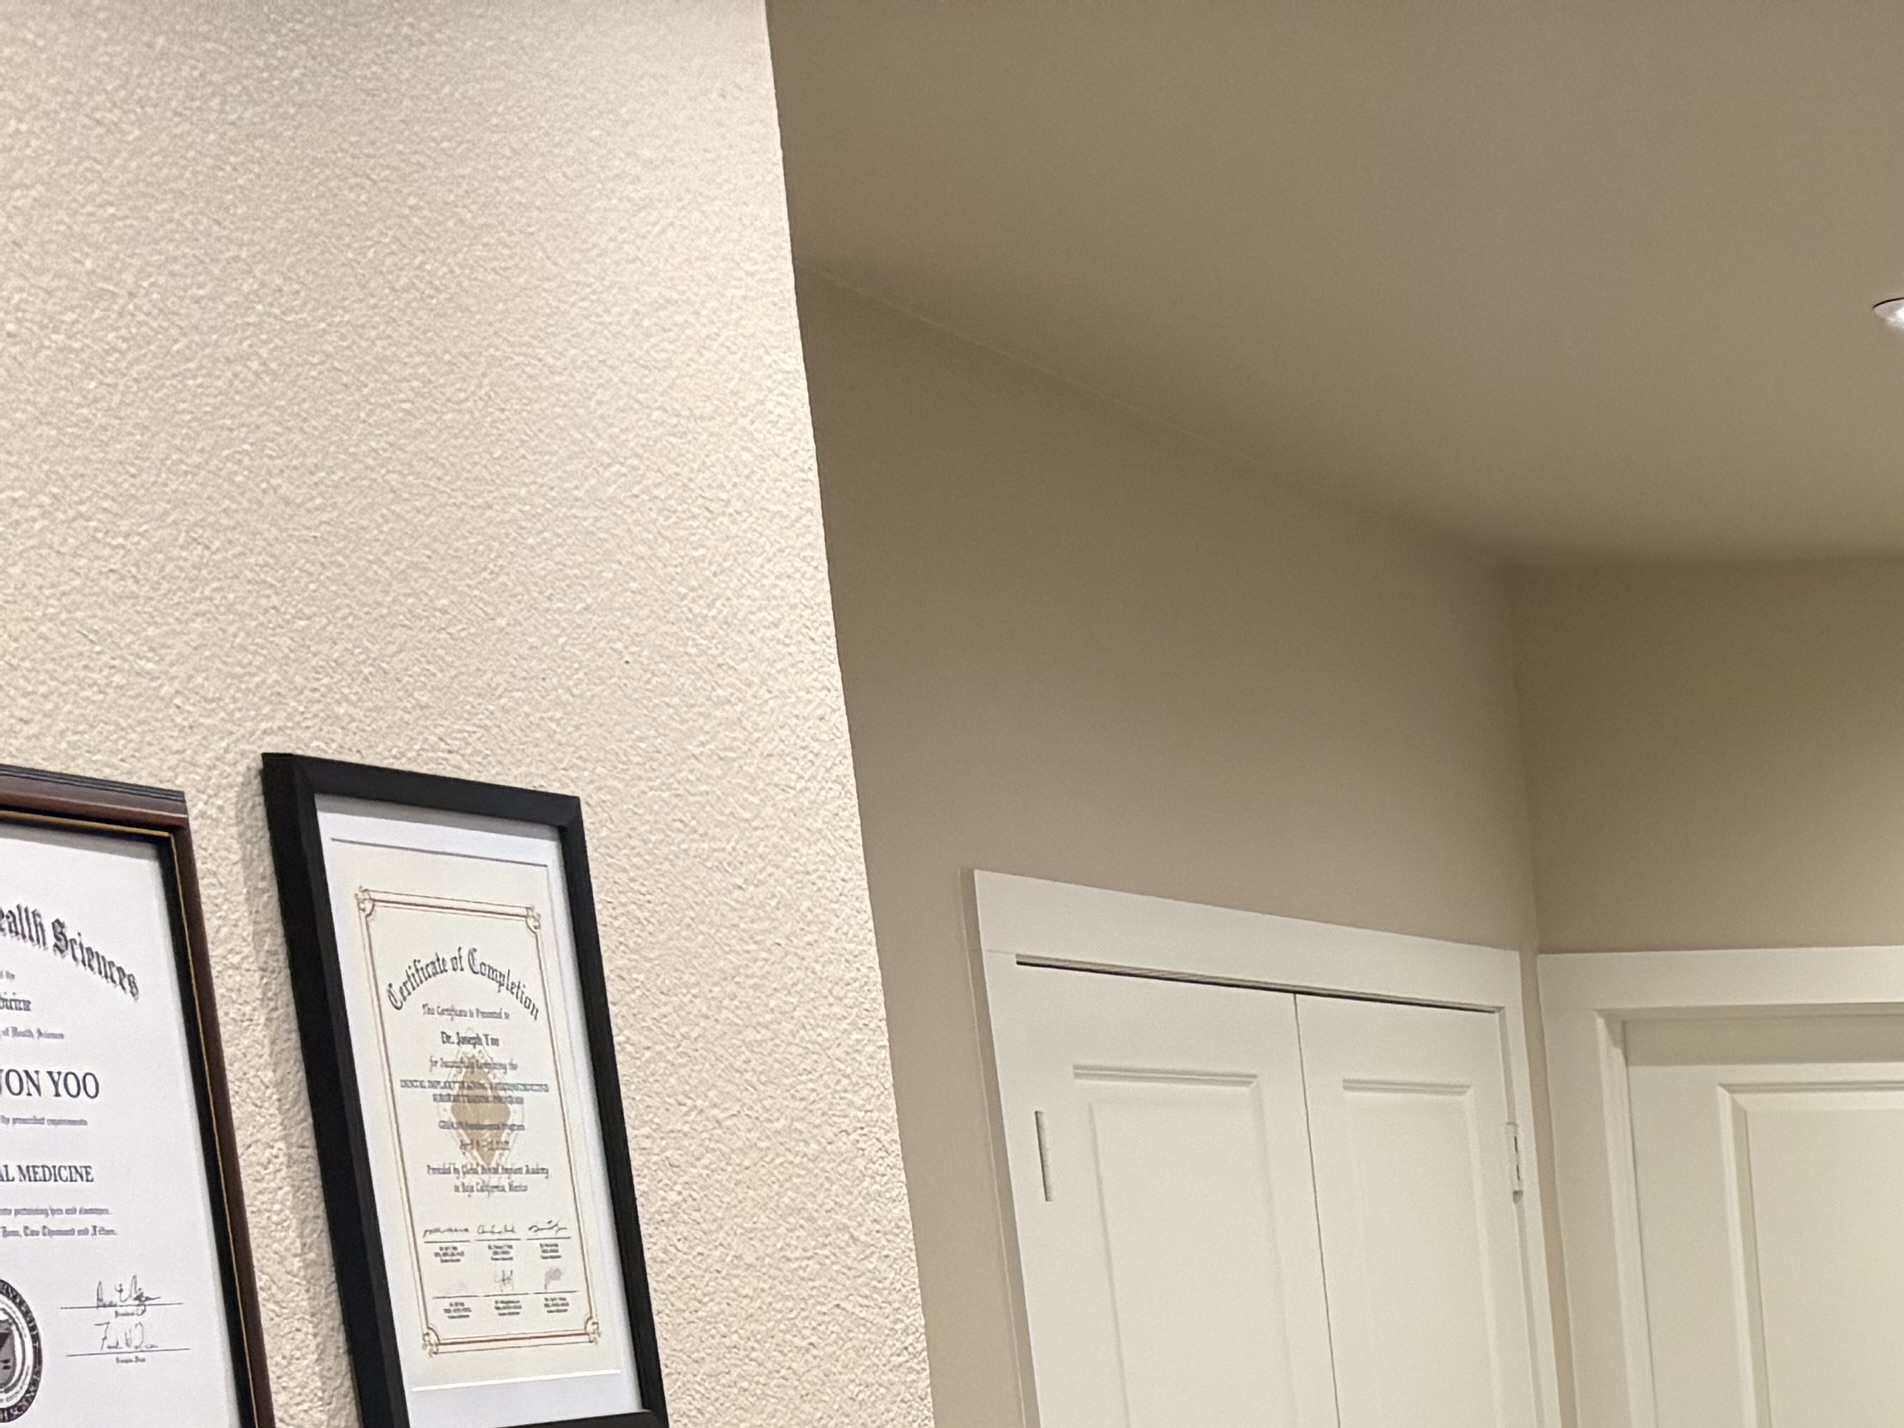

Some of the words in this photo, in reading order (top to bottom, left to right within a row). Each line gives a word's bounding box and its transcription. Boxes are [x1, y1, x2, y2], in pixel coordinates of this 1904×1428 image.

[51, 919, 139, 1001] Sciences
[387, 952, 448, 1011] Certificate
[450, 946, 465, 972] of
[468, 947, 540, 1020] Completion
[46, 1070, 100, 1099] YOO
[18, 1164, 94, 1183] MEDICINE
